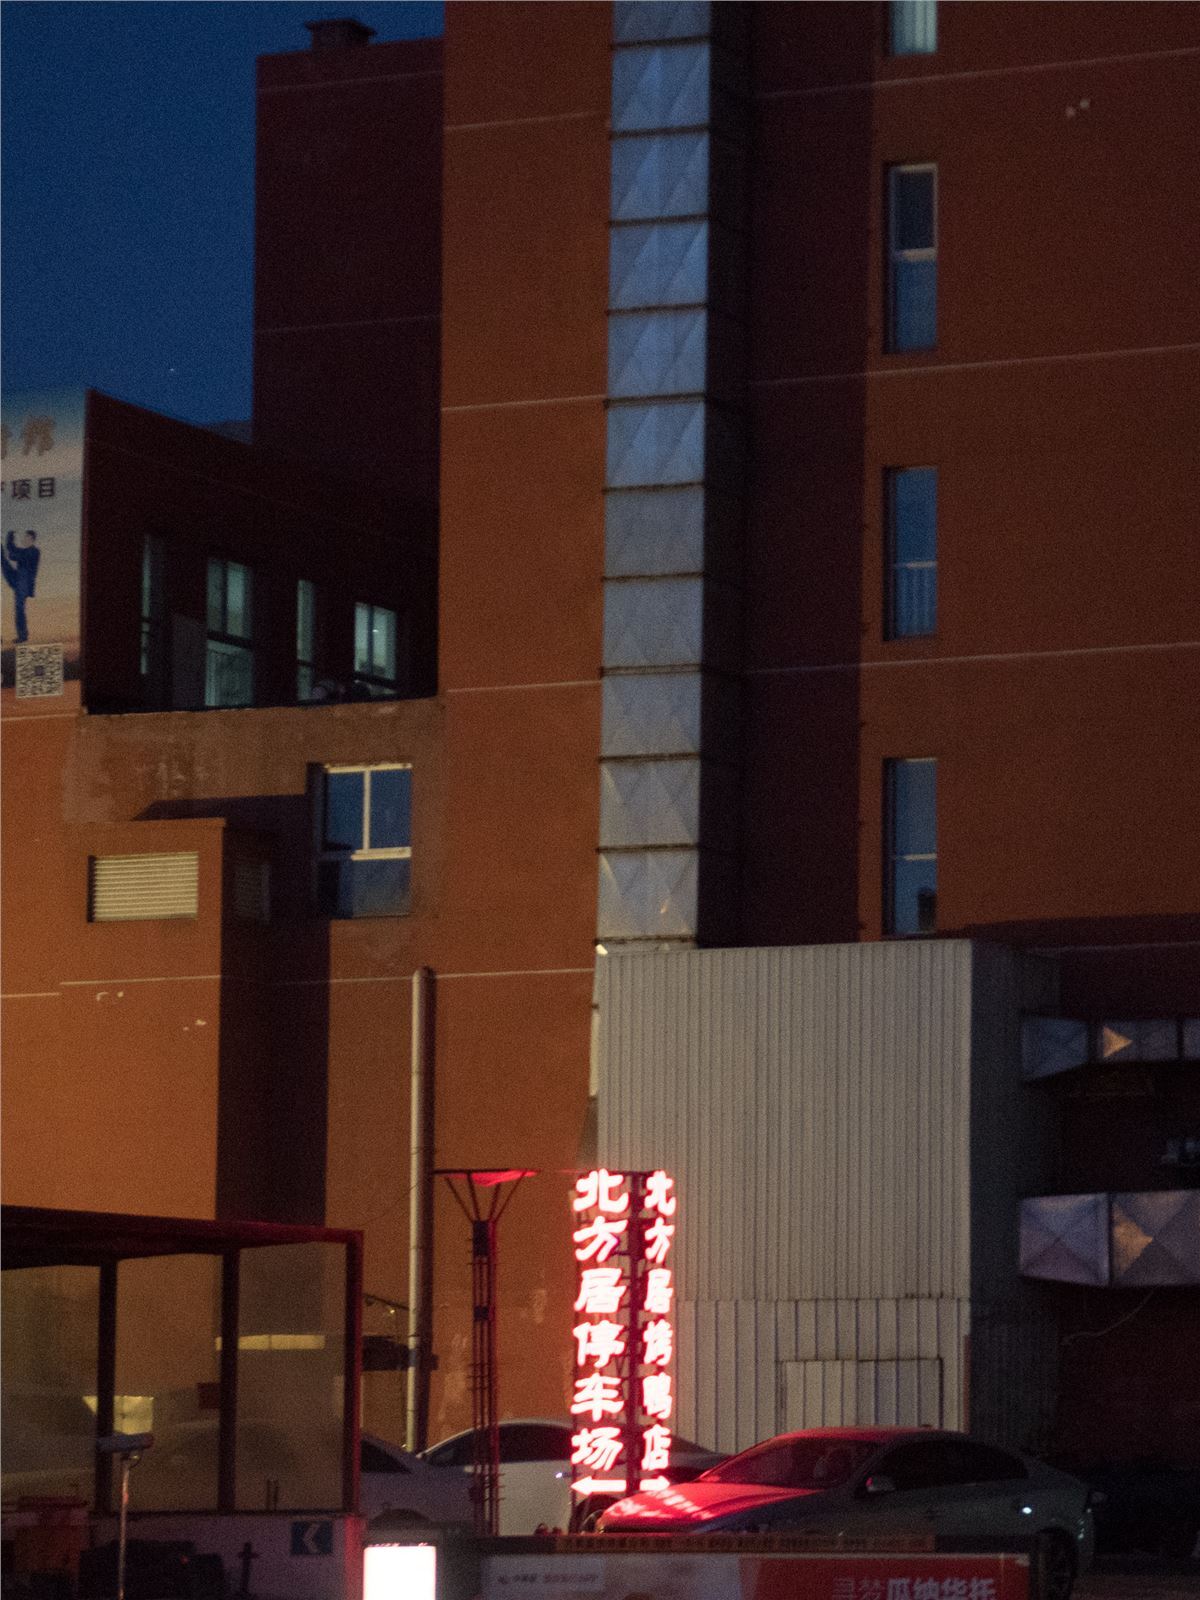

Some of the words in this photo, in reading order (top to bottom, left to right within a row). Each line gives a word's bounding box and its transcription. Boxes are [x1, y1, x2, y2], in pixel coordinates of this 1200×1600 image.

[1, 477, 55, 500] 项目
[570, 1168, 629, 1472] 北方居停车场
[641, 1169, 676, 1471] 北方居烤鸭店
